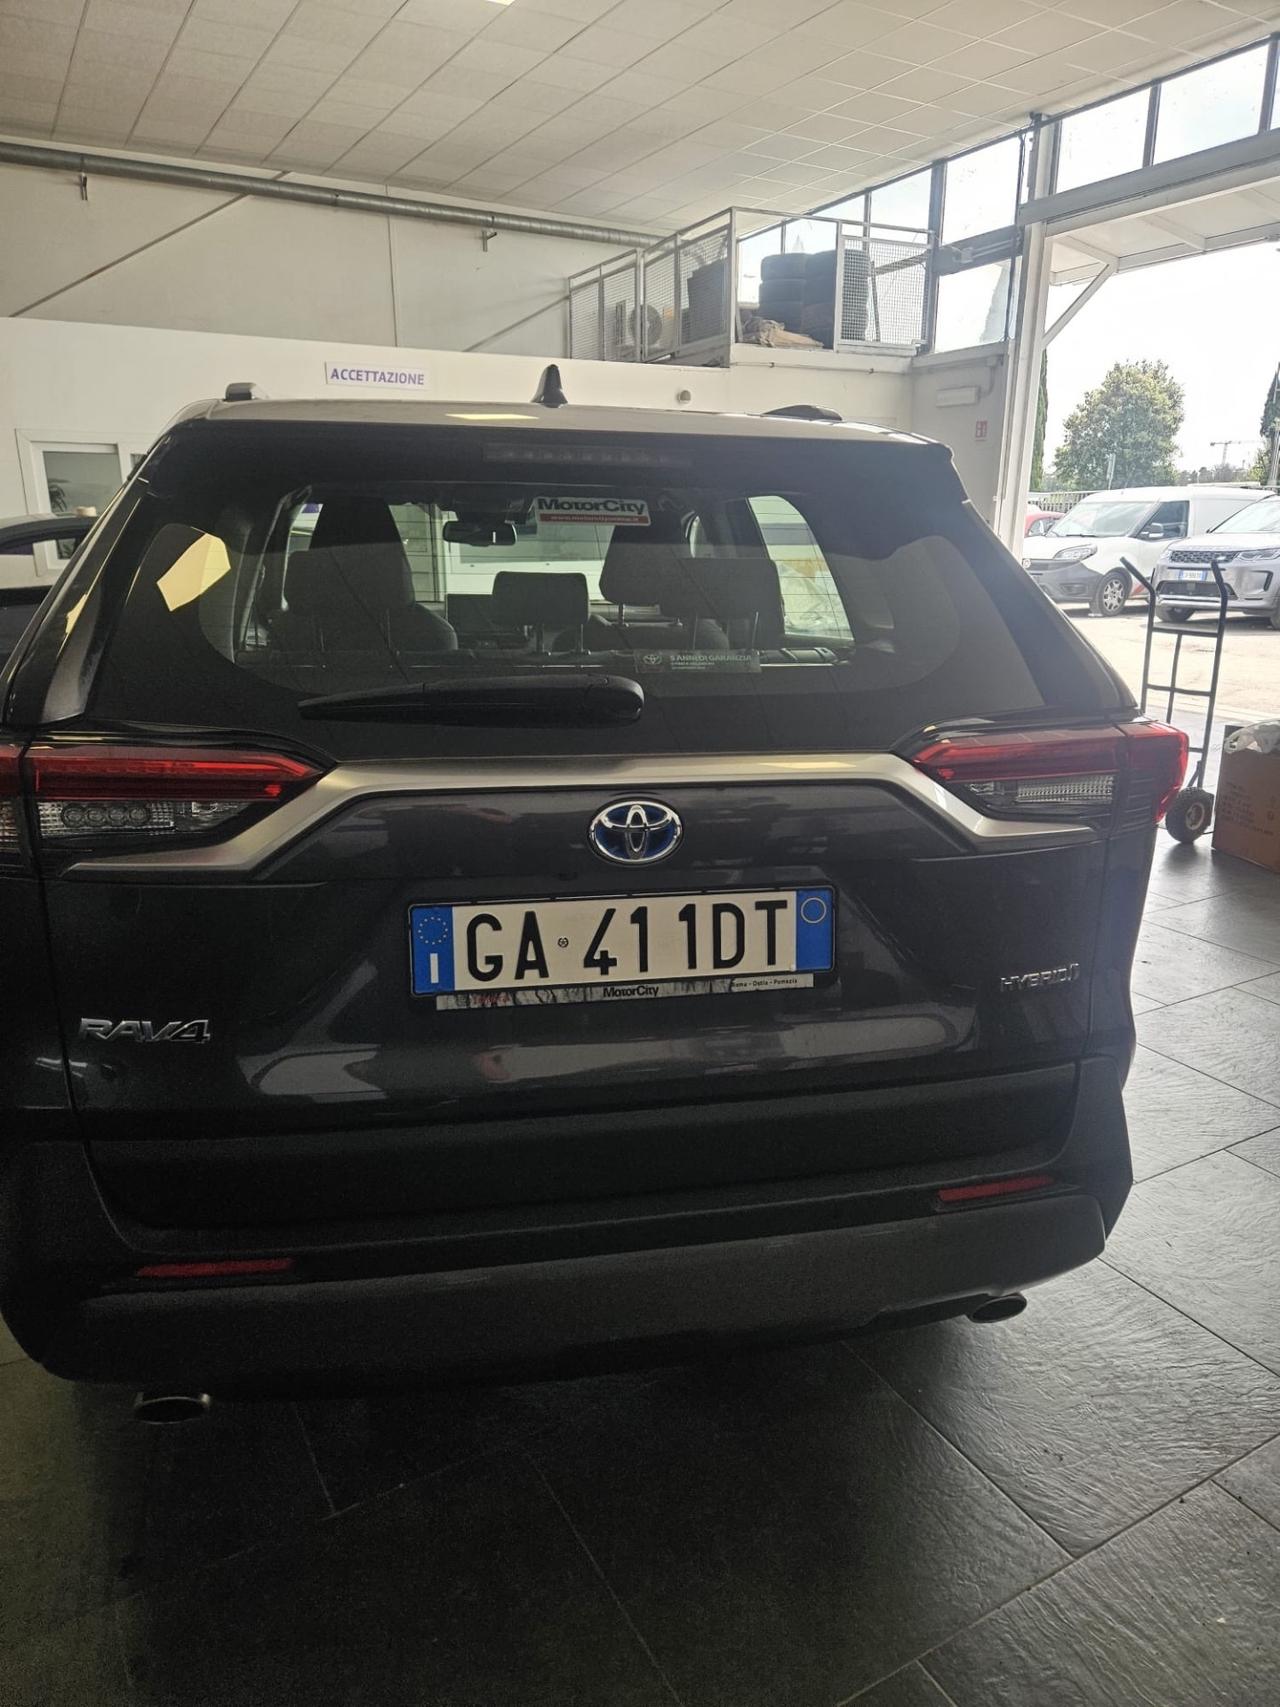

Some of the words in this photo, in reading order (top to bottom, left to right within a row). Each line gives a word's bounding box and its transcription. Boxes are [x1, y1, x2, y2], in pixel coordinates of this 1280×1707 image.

[330, 368, 424, 385] ACCETTAZIONE
[538, 499, 645, 515] MotorCity
[466, 911, 550, 982] GA
[430, 953, 439, 984] I
[1000, 963, 1079, 993] HYBRID
[603, 985, 659, 997] MotorCity
[79, 1018, 210, 1043] RAV4
